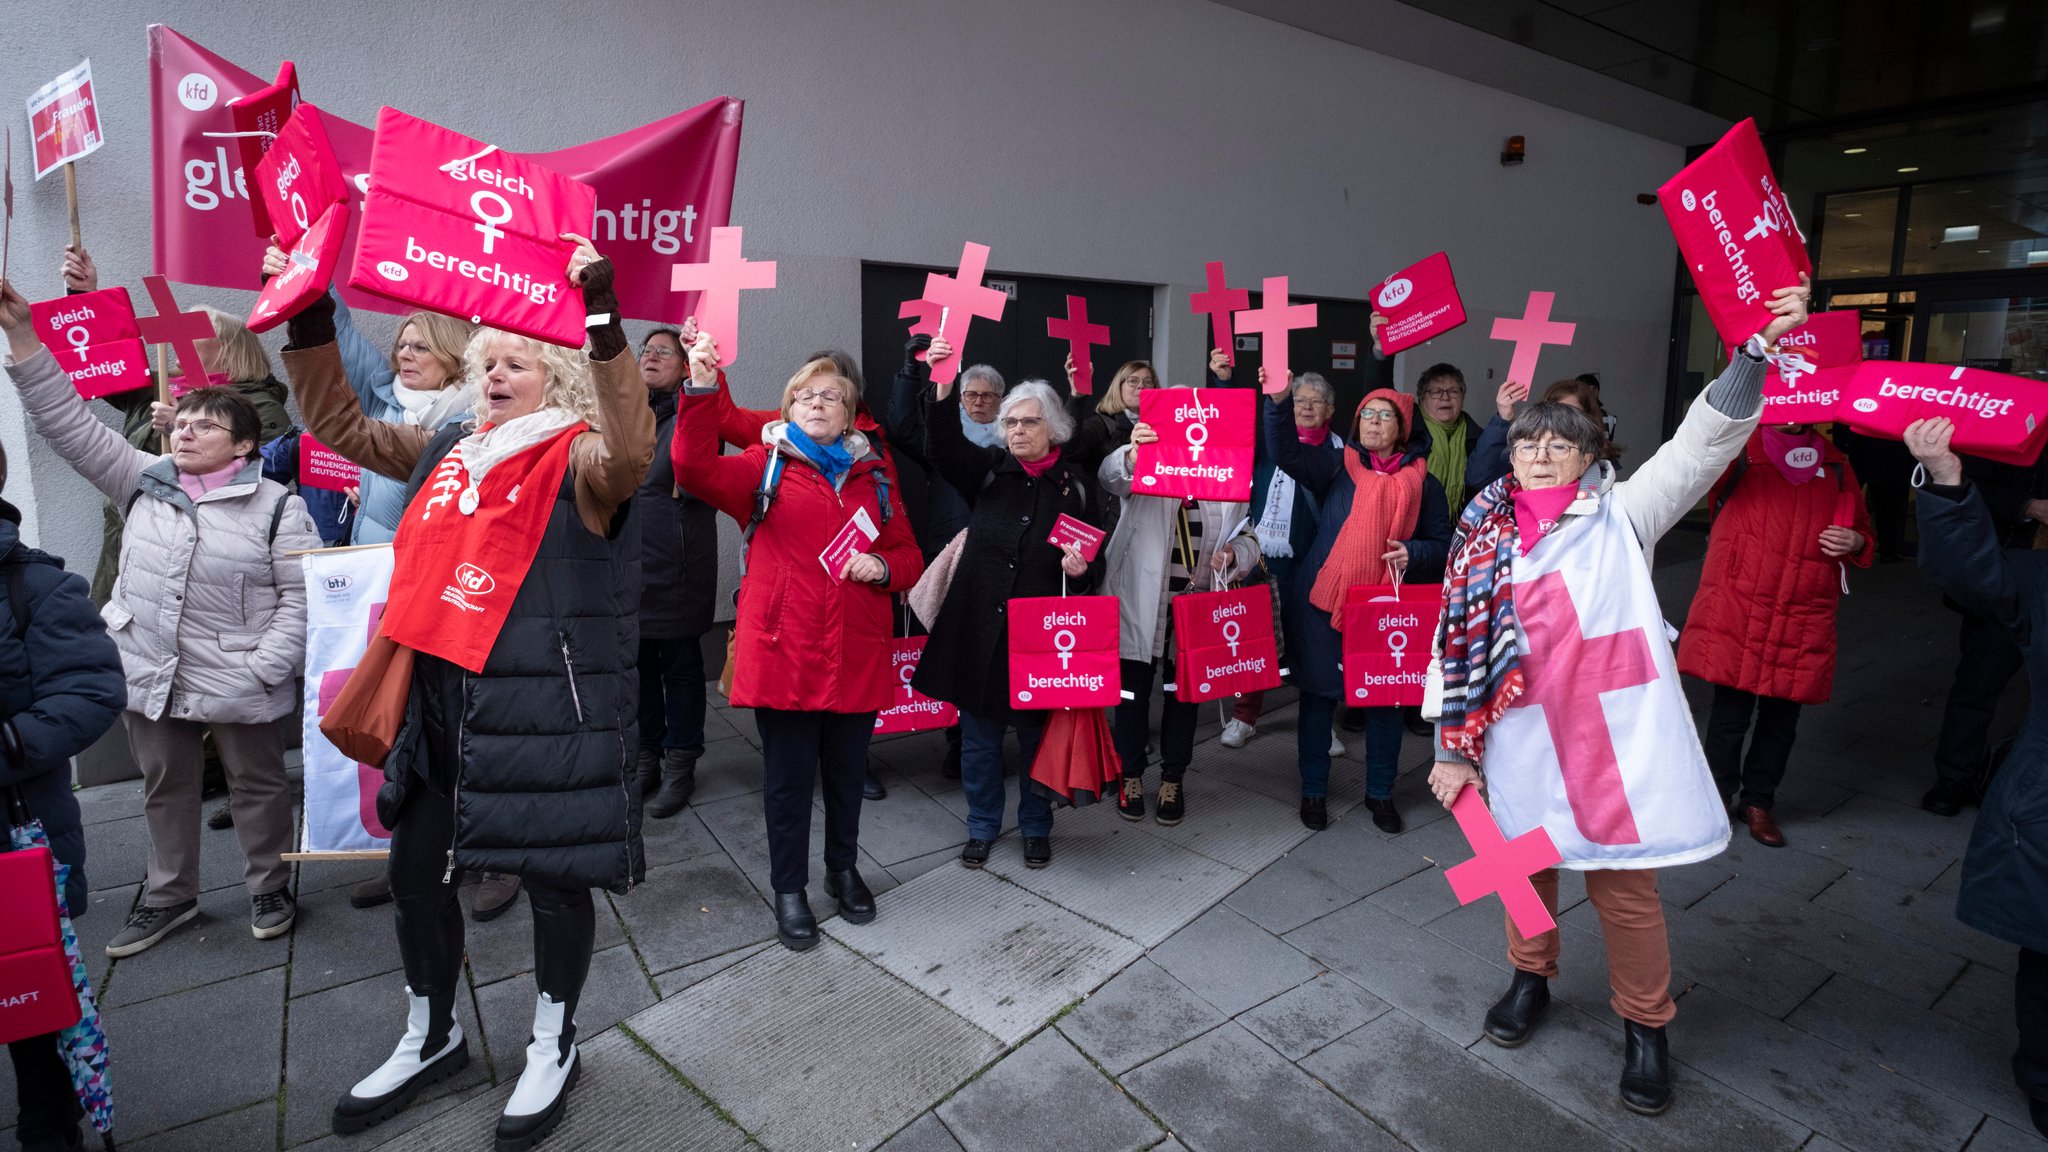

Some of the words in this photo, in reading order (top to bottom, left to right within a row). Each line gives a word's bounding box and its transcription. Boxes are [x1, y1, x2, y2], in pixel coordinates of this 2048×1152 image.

[186, 83, 208, 100] kfd
[277, 153, 301, 201] gleich
[449, 159, 534, 201] gleich
[1761, 175, 1791, 237] gleich
[1701, 190, 1762, 305] berechtigt
[383, 264, 402, 277] kfd
[405, 236, 557, 305] berechtigt
[1384, 283, 1406, 302] kfd
[50, 306, 96, 330] gleich
[1385, 311, 1423, 331] KATHOLISCHE
[1386, 304, 1451, 337] FRAUENGEMEINSCHAFT
[1388, 320, 1434, 342] DEUTSCHLANDS
[1857, 400, 1873, 409] kfd
[1878, 377, 2015, 419] berechtigt
[1793, 453, 1812, 463] kfd
[1155, 461, 1234, 482] berechtigt
[1060, 520, 1098, 542] Frauenweihe
[1043, 611, 1087, 630] gleich
[1212, 602, 1247, 623] gleich
[1378, 614, 1419, 631] gleich
[1206, 657, 1266, 679] berechtigt
[1028, 673, 1104, 691] berechtigt
